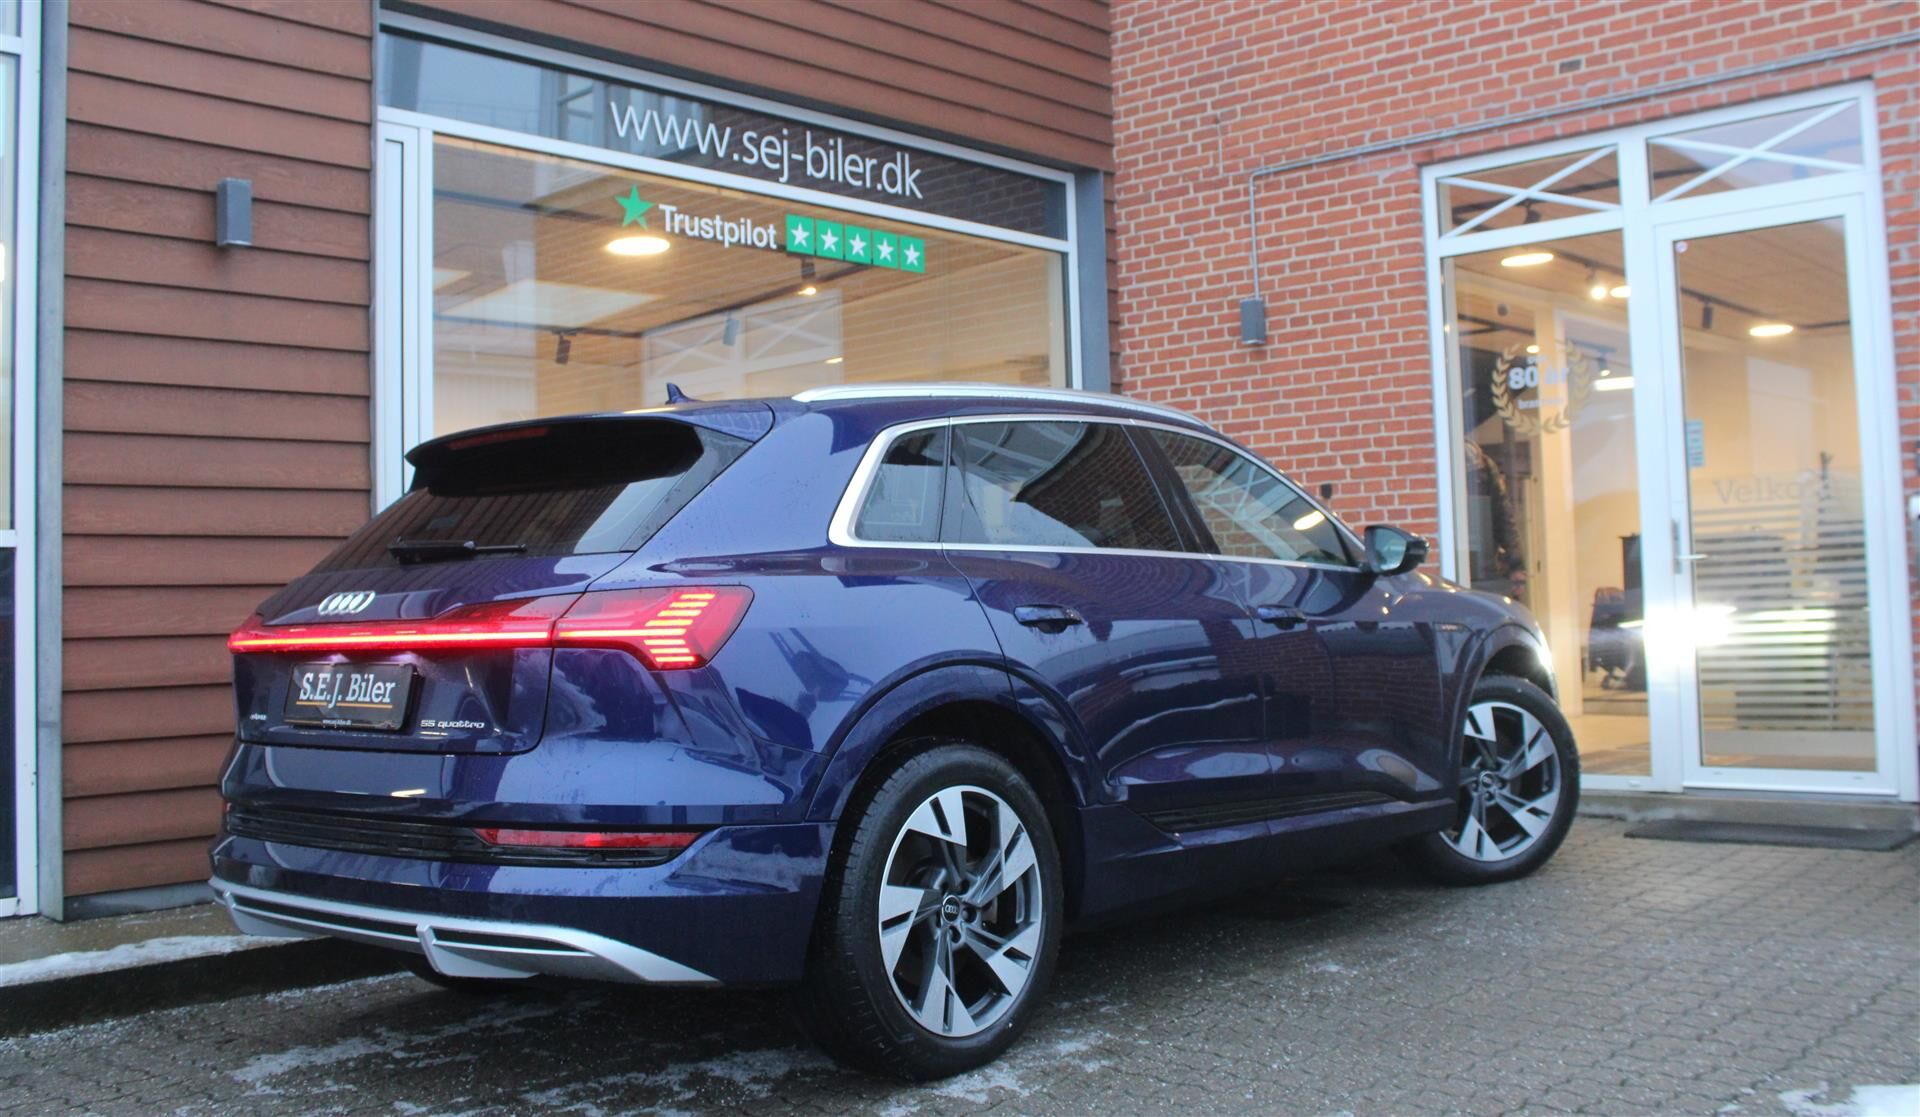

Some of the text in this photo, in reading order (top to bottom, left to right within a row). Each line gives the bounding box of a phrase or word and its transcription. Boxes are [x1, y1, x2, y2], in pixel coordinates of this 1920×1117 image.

[610, 101, 923, 199] www.sej-biler.dk
[658, 203, 778, 250] Trustpilot
[1508, 366, 1539, 390] 80
[299, 672, 396, 708] S.E.J. Biler
[437, 720, 485, 729] quattro
